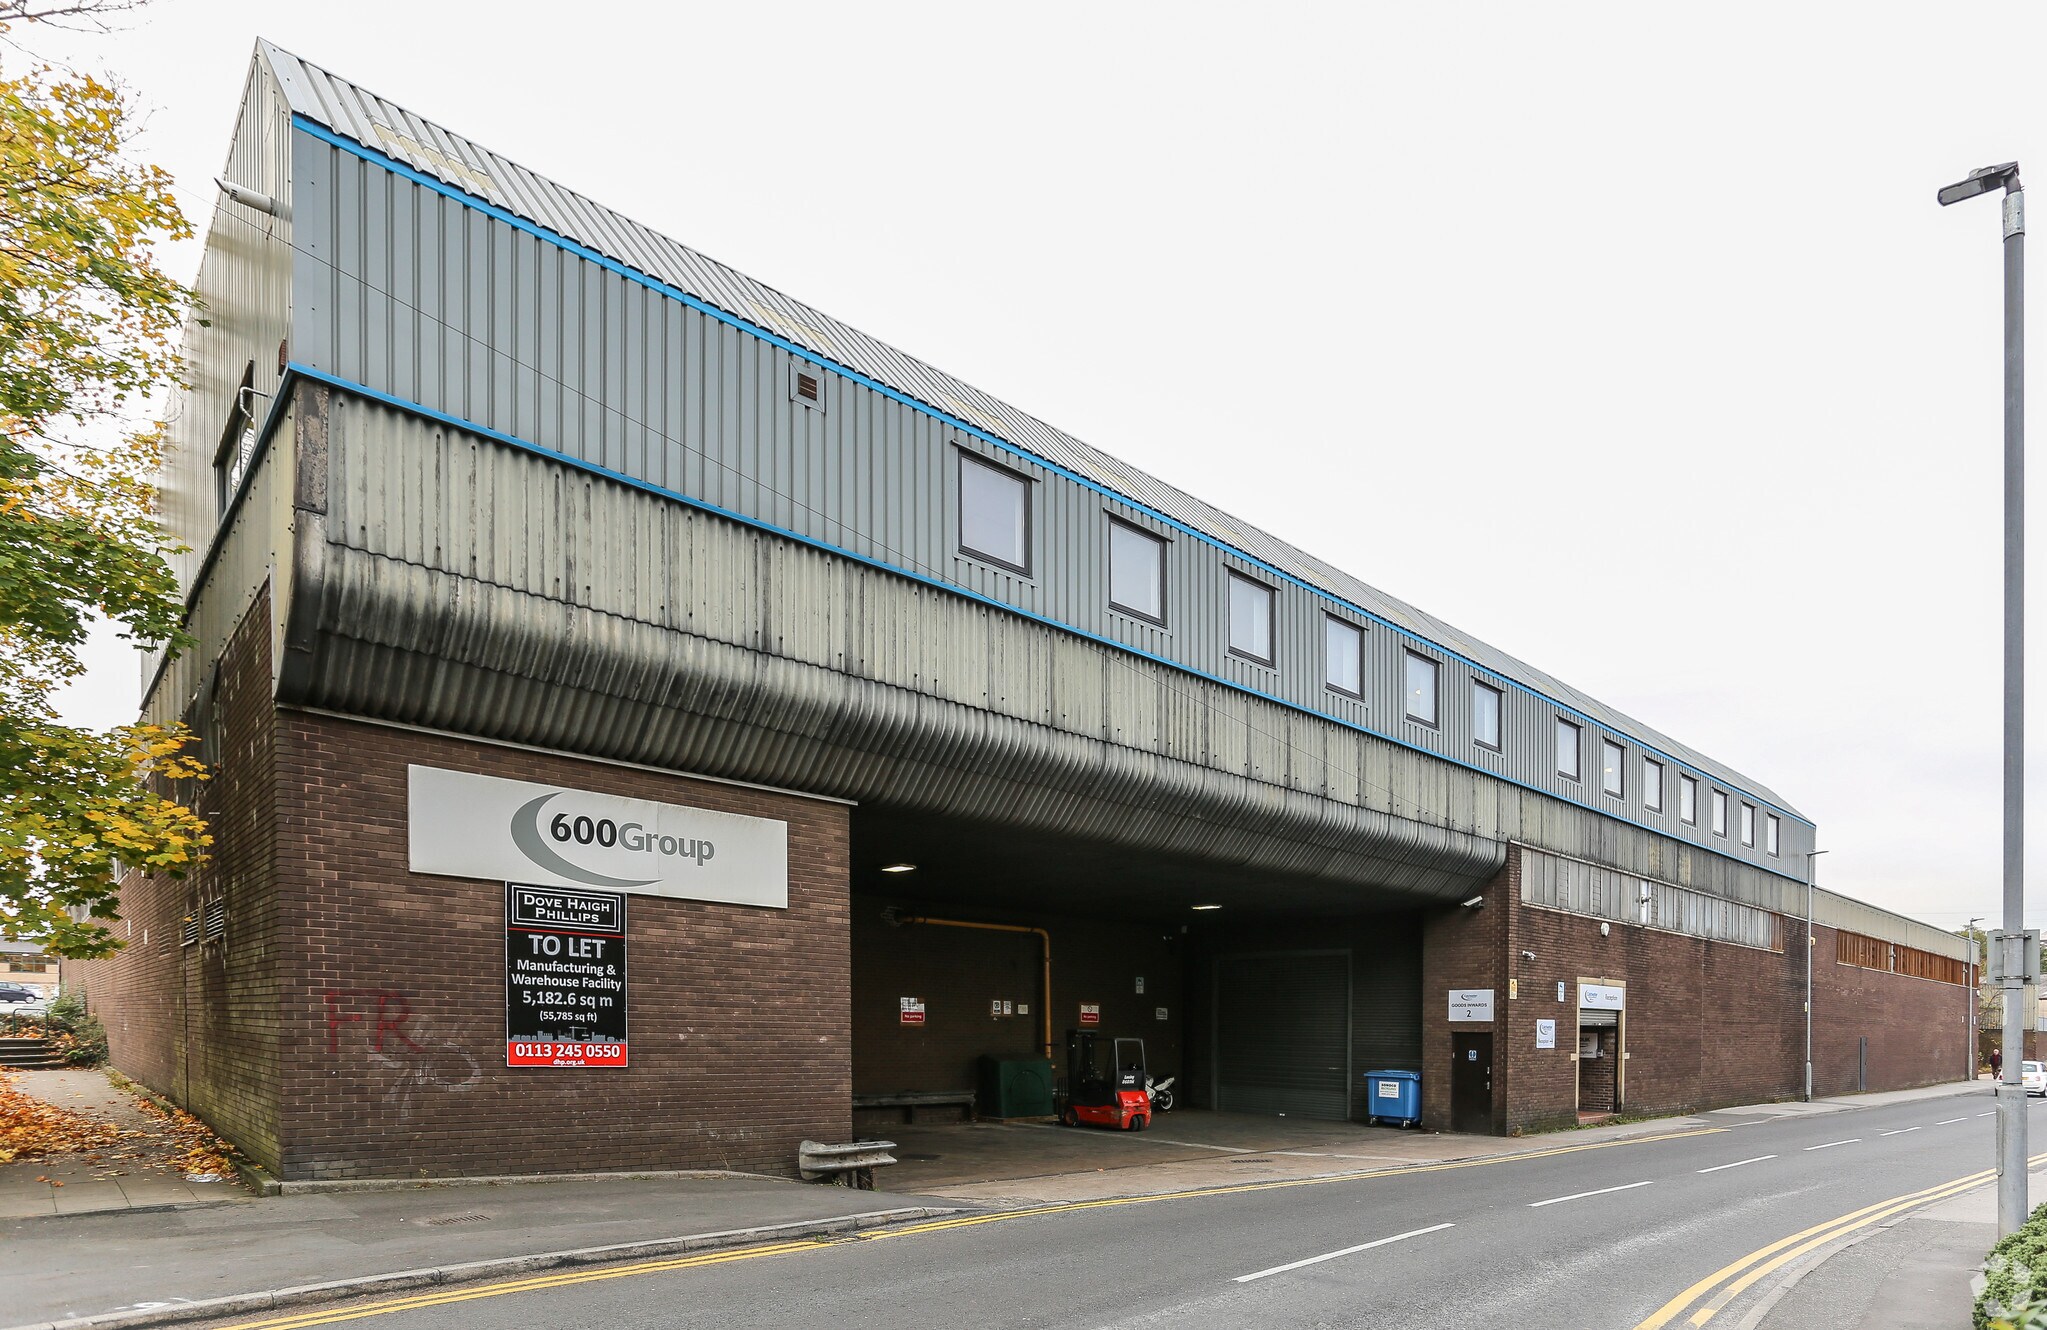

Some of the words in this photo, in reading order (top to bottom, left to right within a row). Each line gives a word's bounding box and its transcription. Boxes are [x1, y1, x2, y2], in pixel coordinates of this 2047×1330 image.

[550, 812, 715, 867] 600Group
[523, 893, 563, 909] DOVE
[567, 898, 610, 913] HAIGH
[535, 907, 600, 923] PHILLIPS
[528, 934, 561, 956] TO
[568, 937, 606, 959] LET
[516, 959, 604, 977] Manufacturing
[606, 964, 617, 976] &
[511, 973, 580, 988] Warehouse
[582, 977, 622, 992] Facility
[522, 990, 577, 1007] 5,182.6
[579, 995, 596, 1009] sq
[599, 996, 613, 1007] m
[539, 1010, 573, 1022] (55,785
[574, 1013, 585, 1023] sq
[586, 1012, 598, 1023] ft)
[1466, 1009, 1472, 1018] 2
[515, 1043, 552, 1057] 0113
[556, 1044, 582, 1057] 245
[585, 1045, 621, 1058] 0550
